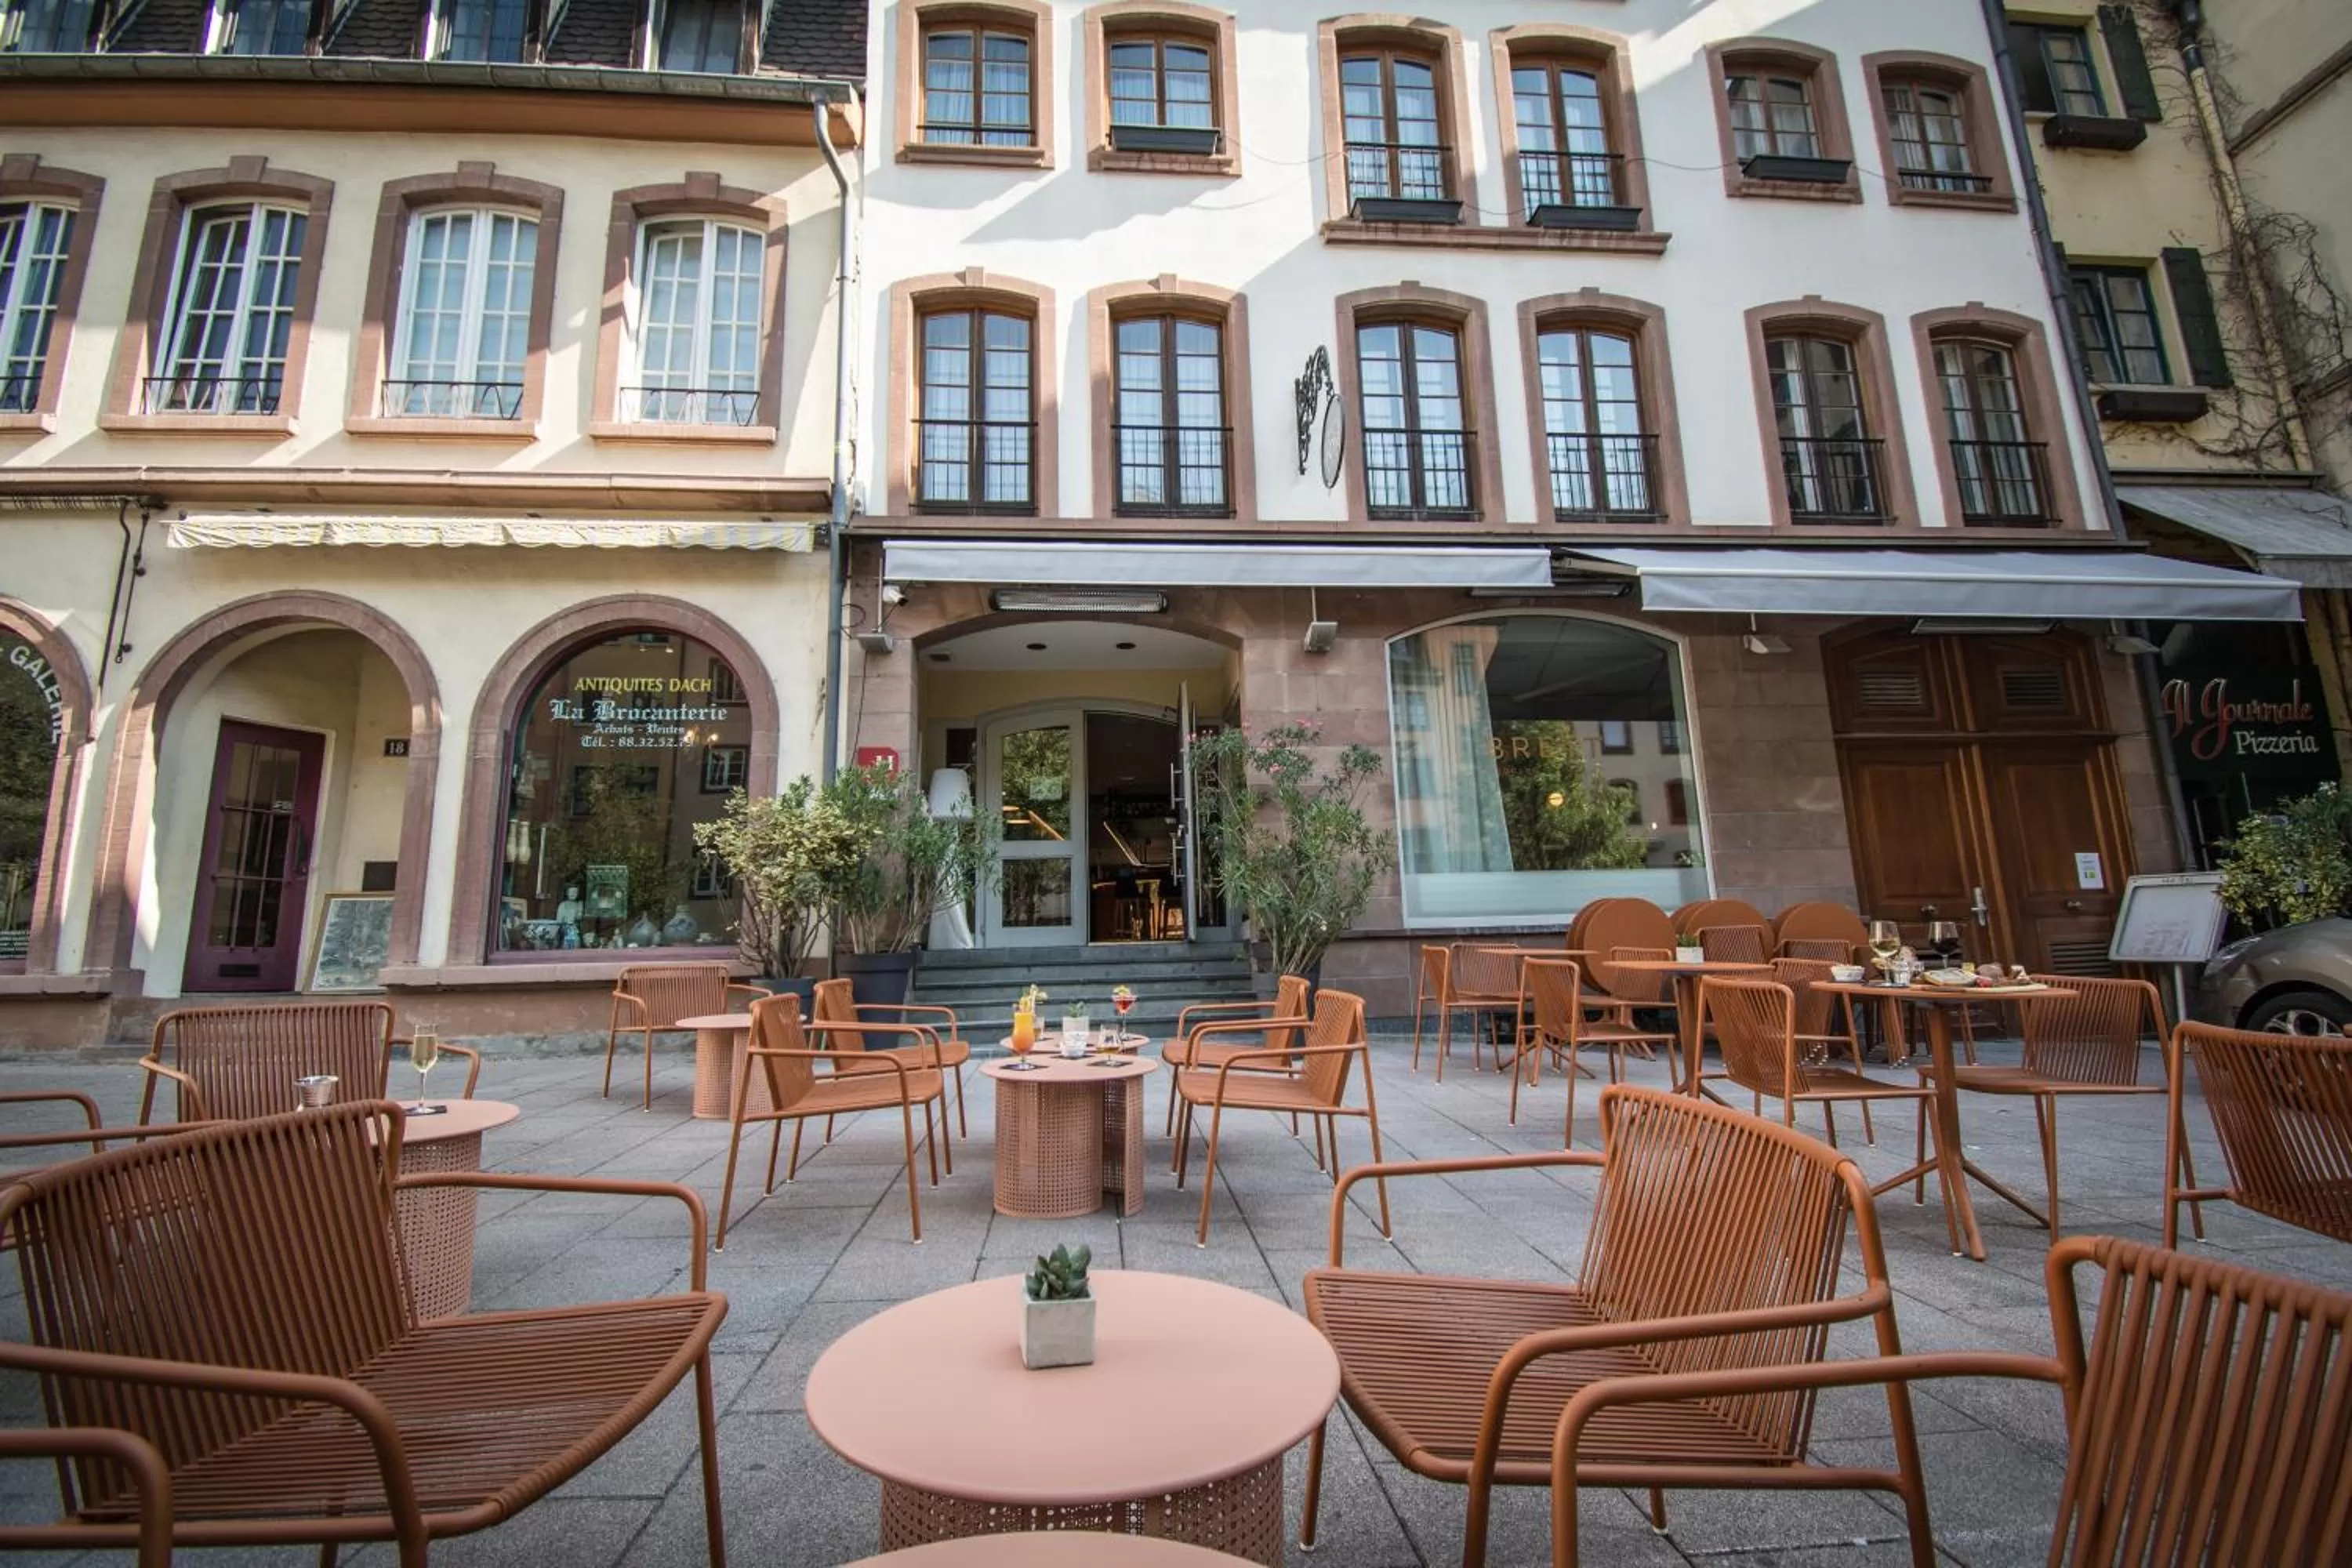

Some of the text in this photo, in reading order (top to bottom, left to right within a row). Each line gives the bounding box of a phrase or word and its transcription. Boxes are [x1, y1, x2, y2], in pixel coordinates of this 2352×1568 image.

[575, 677, 712, 695] ANTIQUITES DACH
[550, 699, 728, 721] La Brocanterie
[645, 723, 685, 735] Ventes
[2234, 730, 2321, 755] Pizzeria
